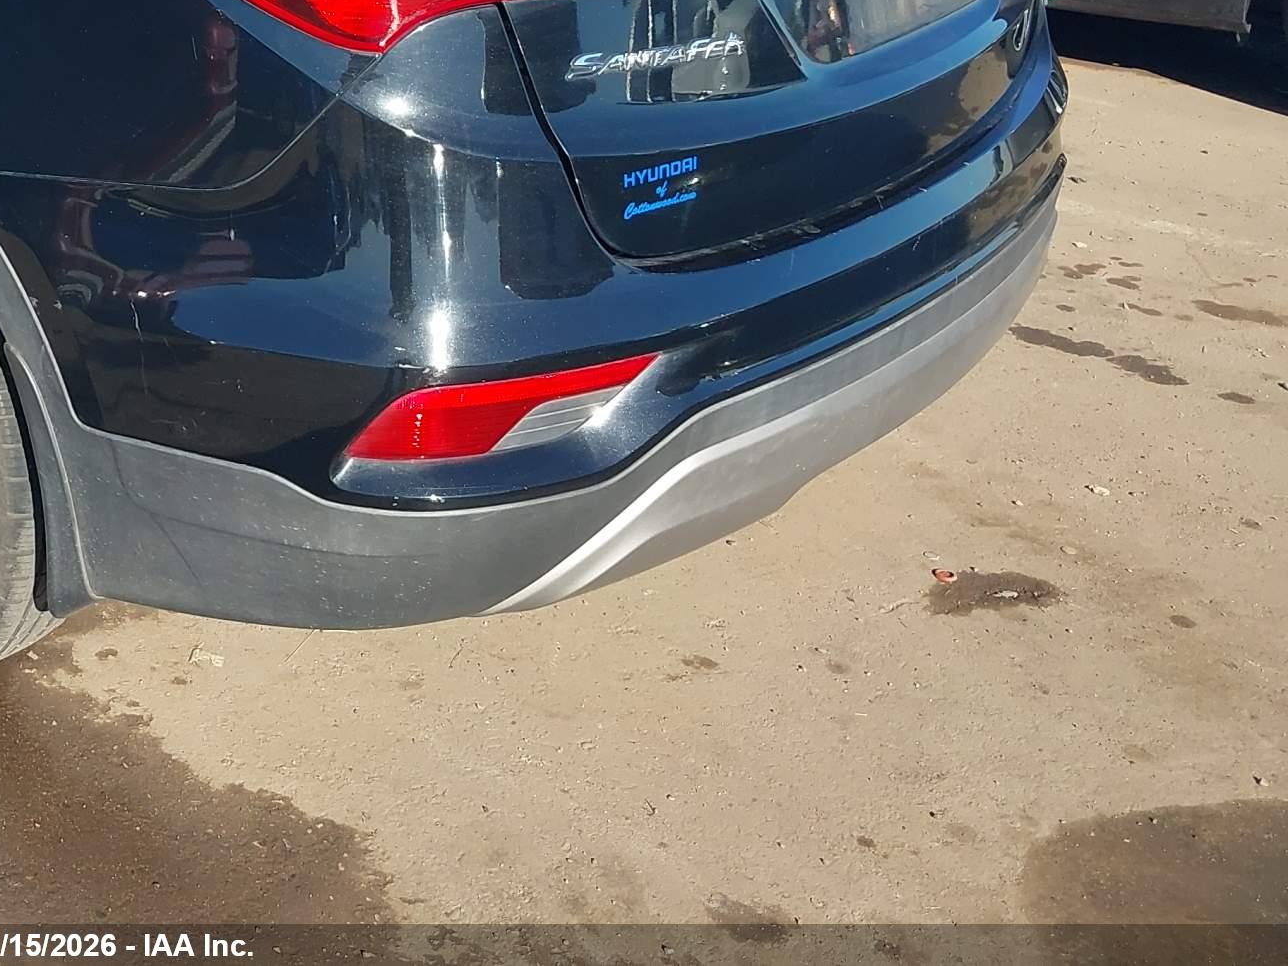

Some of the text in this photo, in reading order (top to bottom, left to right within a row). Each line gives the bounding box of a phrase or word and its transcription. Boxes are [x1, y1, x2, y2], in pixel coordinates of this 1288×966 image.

[564, 45, 686, 81] SANTA
[623, 156, 698, 189] HYUNDAI
[655, 180, 668, 198] of
